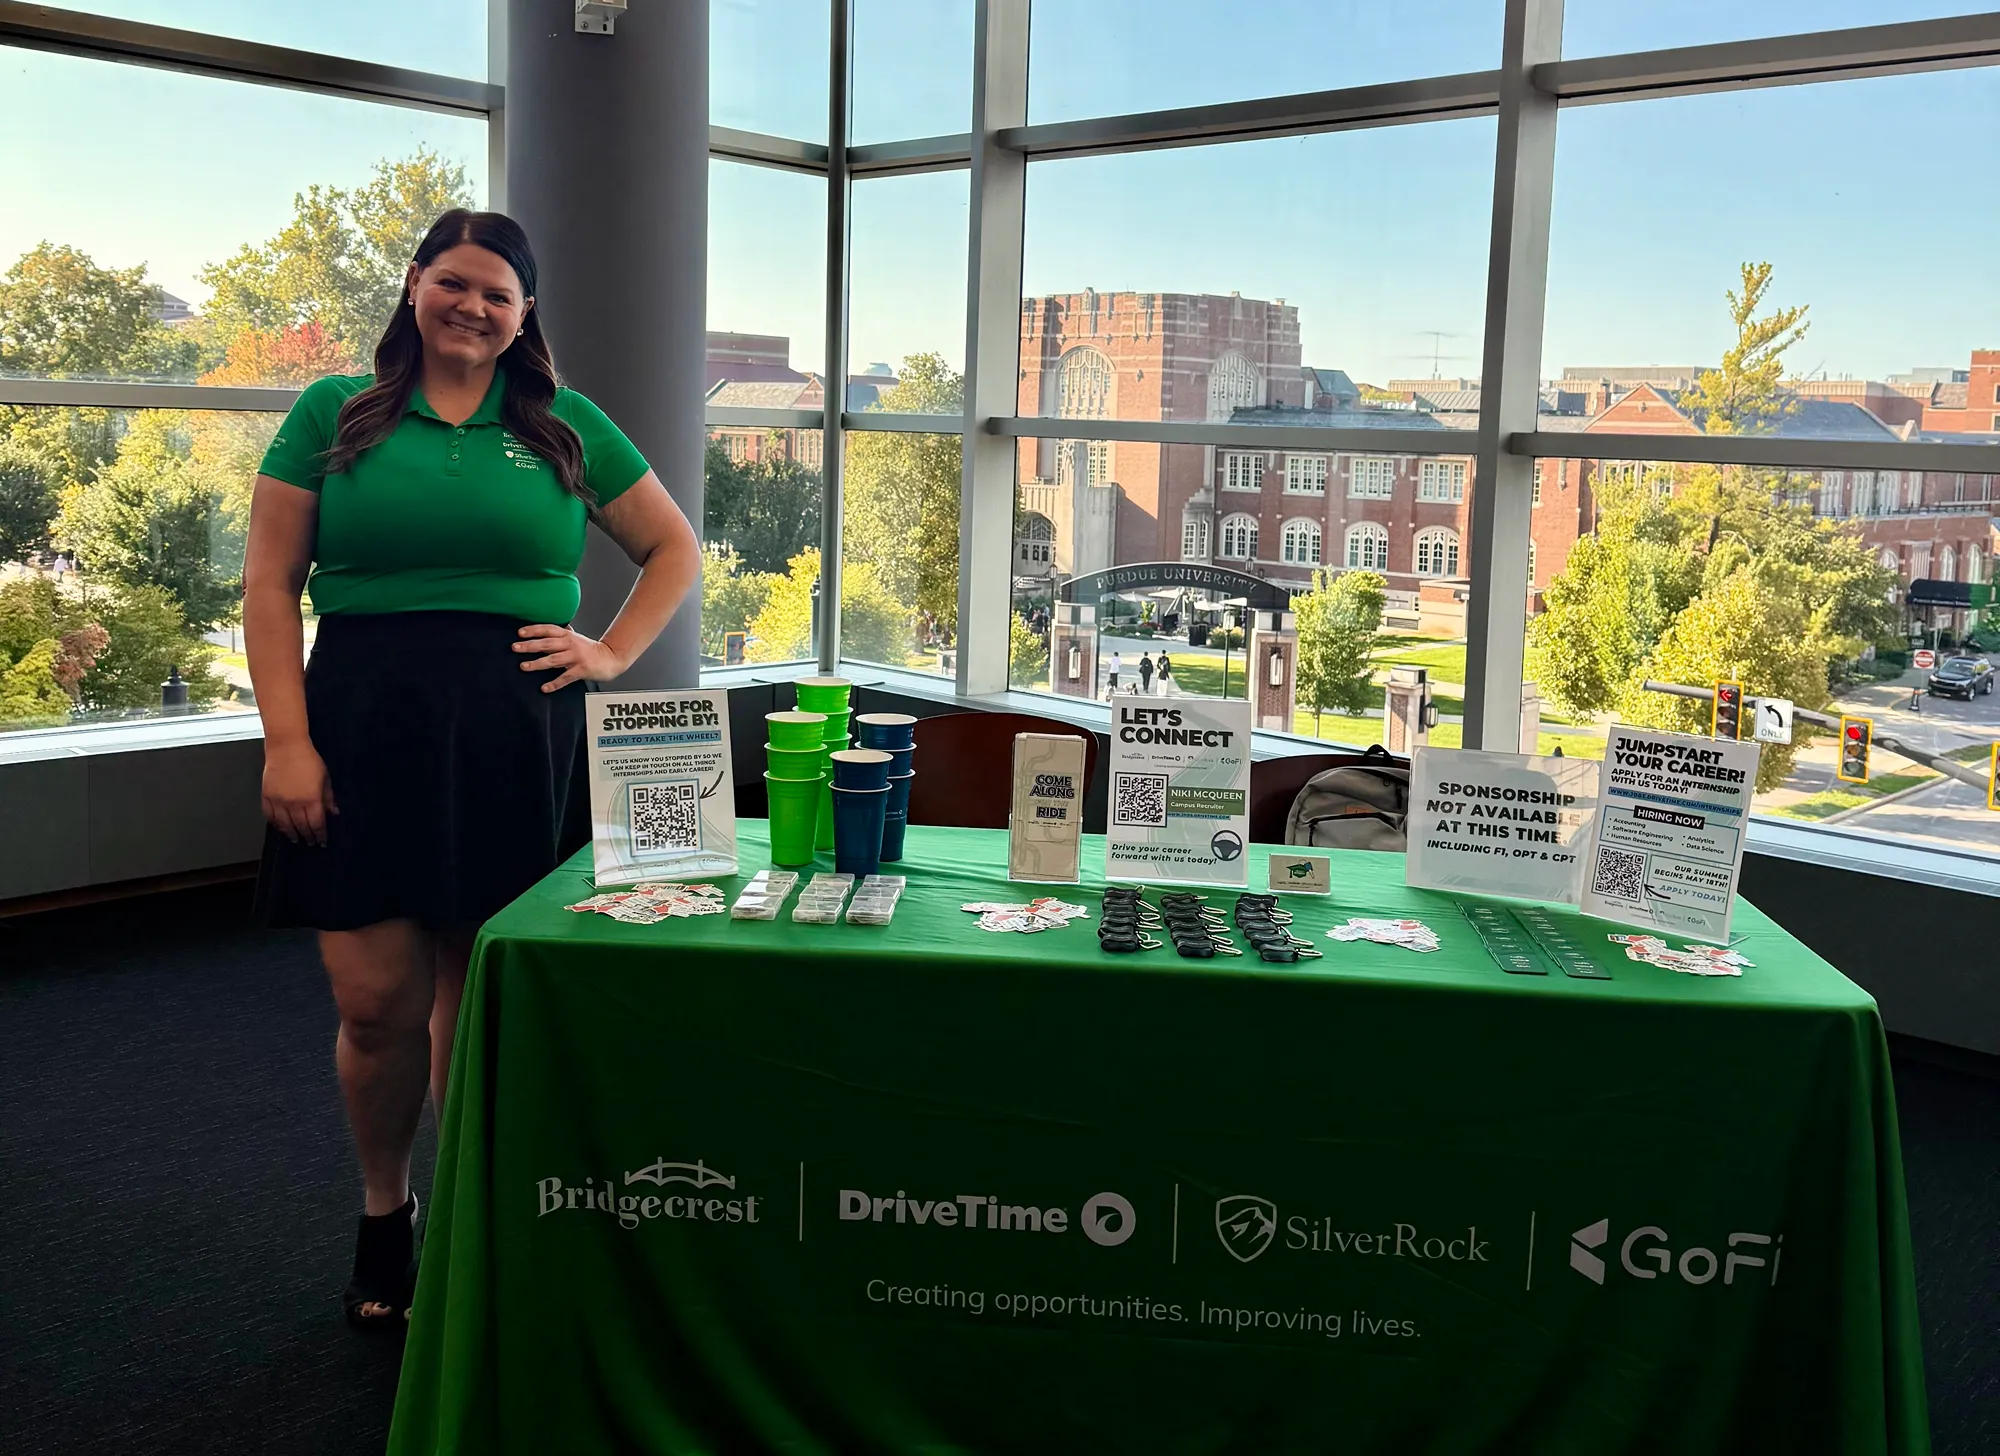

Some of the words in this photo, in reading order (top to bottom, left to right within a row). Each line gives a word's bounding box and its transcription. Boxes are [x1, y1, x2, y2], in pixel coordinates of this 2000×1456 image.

[1096, 568, 1157, 588] PURDUE
[1163, 568, 1257, 593] UNIVERSITY
[607, 701, 676, 716] THANKS
[680, 700, 714, 713] FOR
[1121, 707, 1182, 726] LET'S
[603, 714, 688, 731] STOPPING
[692, 713, 719, 726] BY!
[601, 736, 629, 745] READY
[646, 735, 666, 743] TAKE
[1120, 726, 1233, 748] CONNECT
[1761, 728, 1784, 738] ONLY
[1616, 737, 1723, 765] JUMPSTART
[1615, 751, 1663, 771] YOUR
[1667, 760, 1746, 783] CAREER!
[1035, 774, 1073, 788] COME
[1611, 775, 1636, 785] WITH
[1638, 779, 1650, 788] US
[1652, 781, 1688, 794] TODAY!
[1612, 768, 1642, 779] APPLY
[1644, 773, 1663, 783] FOR
[1665, 776, 1679, 785] AN
[1682, 779, 1740, 795] INTERNSHIP
[1029, 784, 1075, 799] ALONG
[1171, 789, 1191, 797] NIKI
[1193, 791, 1243, 800] MCQUEEN
[1438, 782, 1575, 806] SPONSORSHIP
[1036, 806, 1067, 819] RIDE
[1426, 800, 1466, 814] NOT
[1470, 804, 1581, 827] AVAILABLE
[1637, 809, 1673, 823] HIRING
[1675, 816, 1702, 827] NOW
[1436, 820, 1461, 833] AT
[1467, 822, 1509, 838] THIS
[1516, 827, 1567, 845] TIME.
[1614, 818, 1646, 829] Accounting
[1611, 833, 1631, 841] Human
[1633, 837, 1662, 847] Resources
[1612, 825, 1637, 834] Software
[1639, 830, 1673, 841] Engineering
[1687, 835, 1715, 844] Analytics
[1111, 852, 1148, 860] forward
[1151, 854, 1171, 862] with
[1188, 857, 1217, 865] today!
[1427, 840, 1491, 854] INCLUDING
[1494, 847, 1509, 857] F1,
[1513, 849, 1537, 859] OPT
[1540, 852, 1548, 860] &
[1552, 854, 1576, 864] CPT
[1701, 845, 1725, 854] Science
[1654, 869, 1683, 880] BEGINS
[1686, 875, 1704, 883] MAY
[1706, 878, 1728, 888] 18TH!
[1674, 865, 1692, 873] OUR
[1694, 869, 1729, 880] SUMMER
[1660, 885, 1689, 895] APPLY
[1692, 890, 1725, 903] TODAY!
[536, 1176, 760, 1229] Bridgecrest
[839, 1190, 1068, 1233] DriveTime
[1285, 1215, 1490, 1262] SilverRock
[1621, 1225, 1784, 1287] GoFi
[867, 1279, 986, 1316] Creating
[994, 1289, 1190, 1325] opportunities.
[1200, 1301, 1343, 1339] Improving
[1352, 1311, 1422, 1338] lives.
